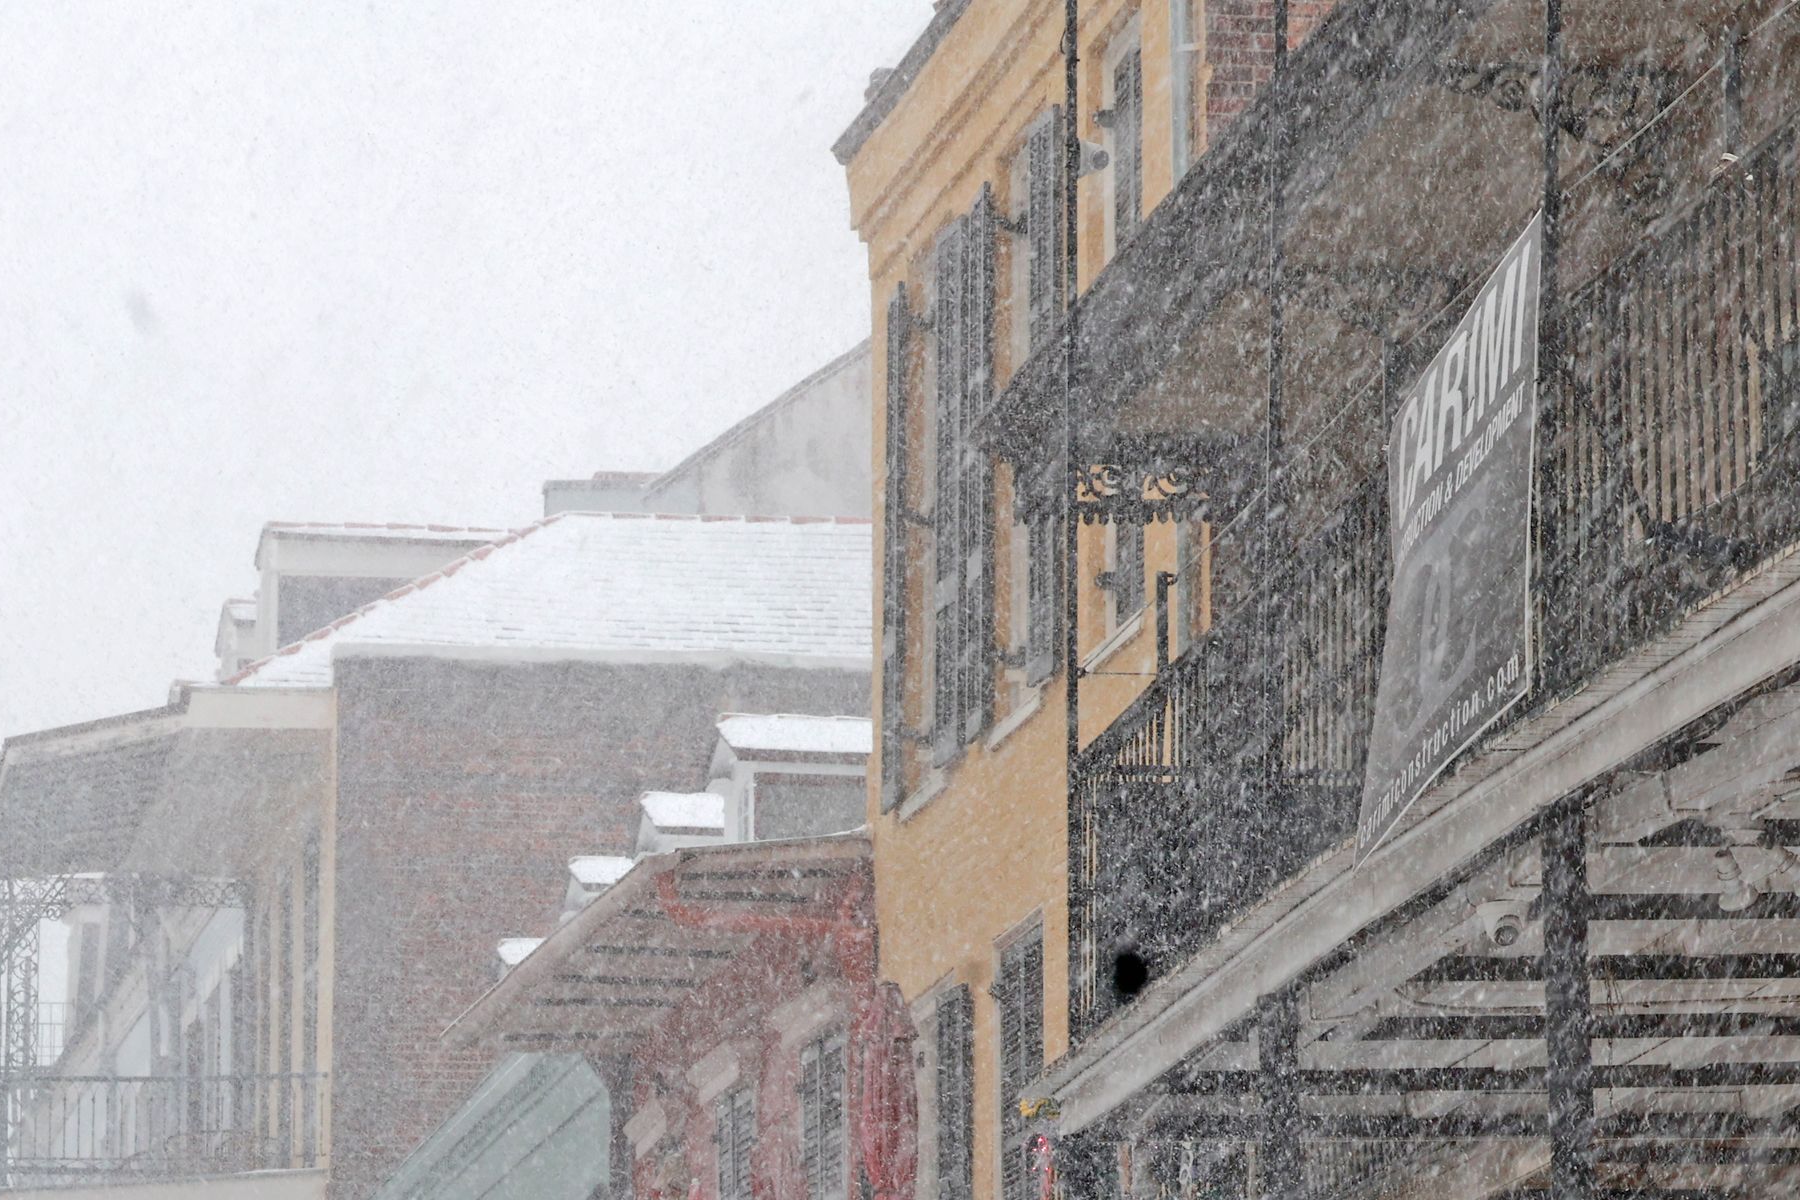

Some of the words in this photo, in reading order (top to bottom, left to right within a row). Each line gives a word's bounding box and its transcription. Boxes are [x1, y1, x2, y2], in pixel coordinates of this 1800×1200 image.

[1398, 239, 1531, 530] CARIMI
[1444, 471, 1454, 504] &
[1454, 379, 1526, 493] DEVELOPMENT
[1359, 653, 1520, 849] carimiconstruction.com
